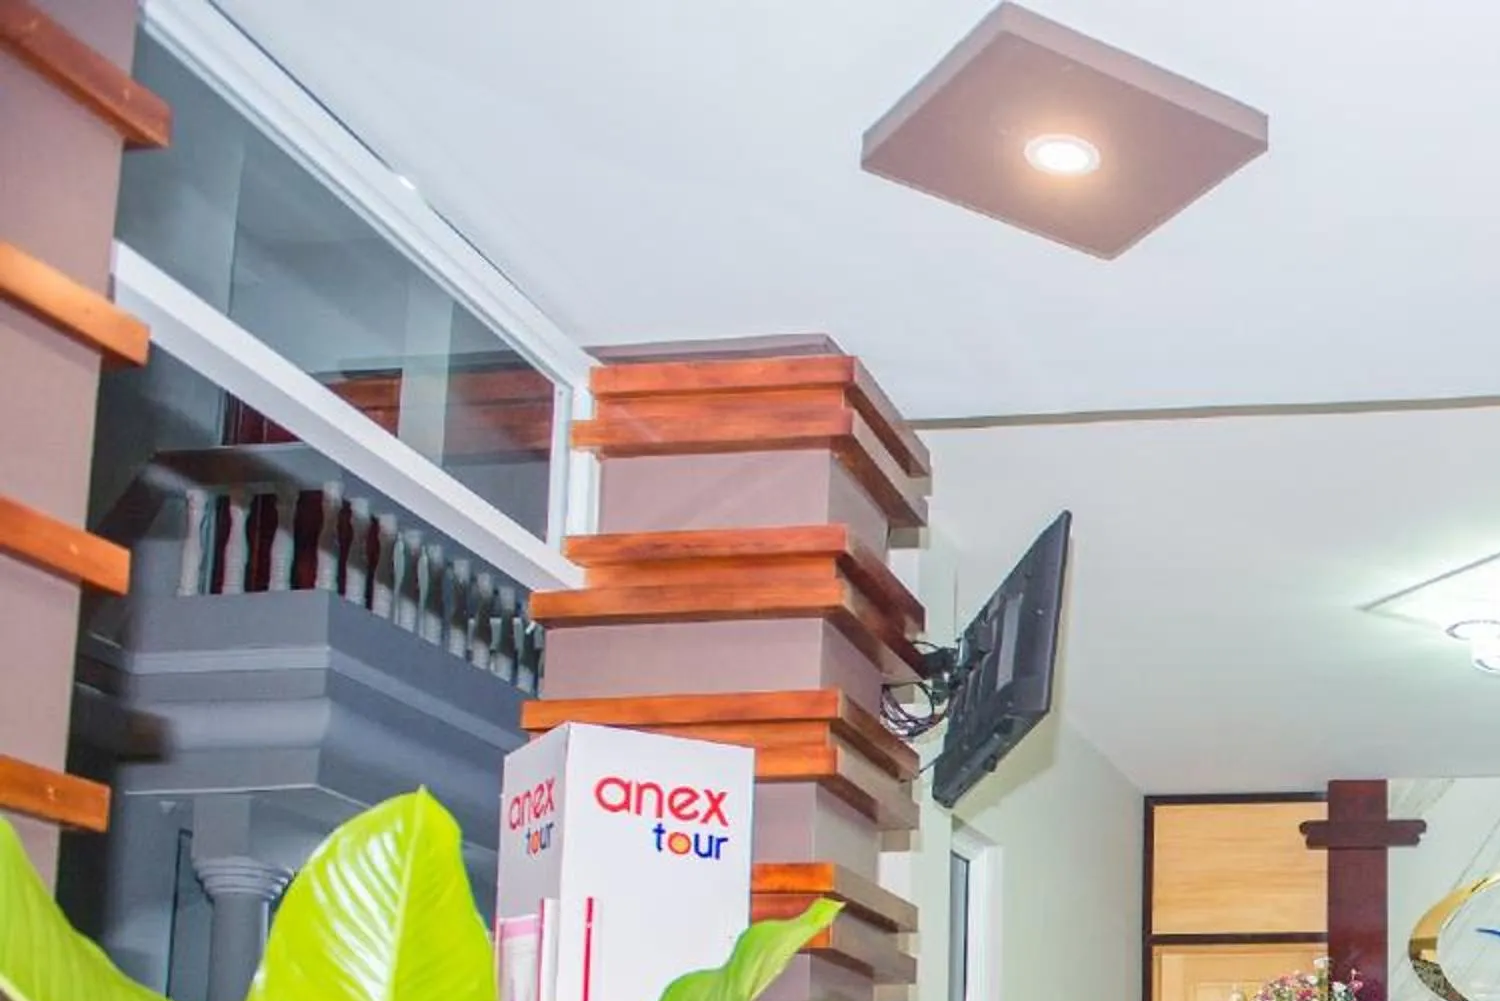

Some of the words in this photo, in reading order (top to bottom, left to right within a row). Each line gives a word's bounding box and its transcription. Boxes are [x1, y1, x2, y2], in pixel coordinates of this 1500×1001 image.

[508, 777, 554, 831] anex
[594, 776, 729, 827] anex
[652, 823, 729, 860] tour
